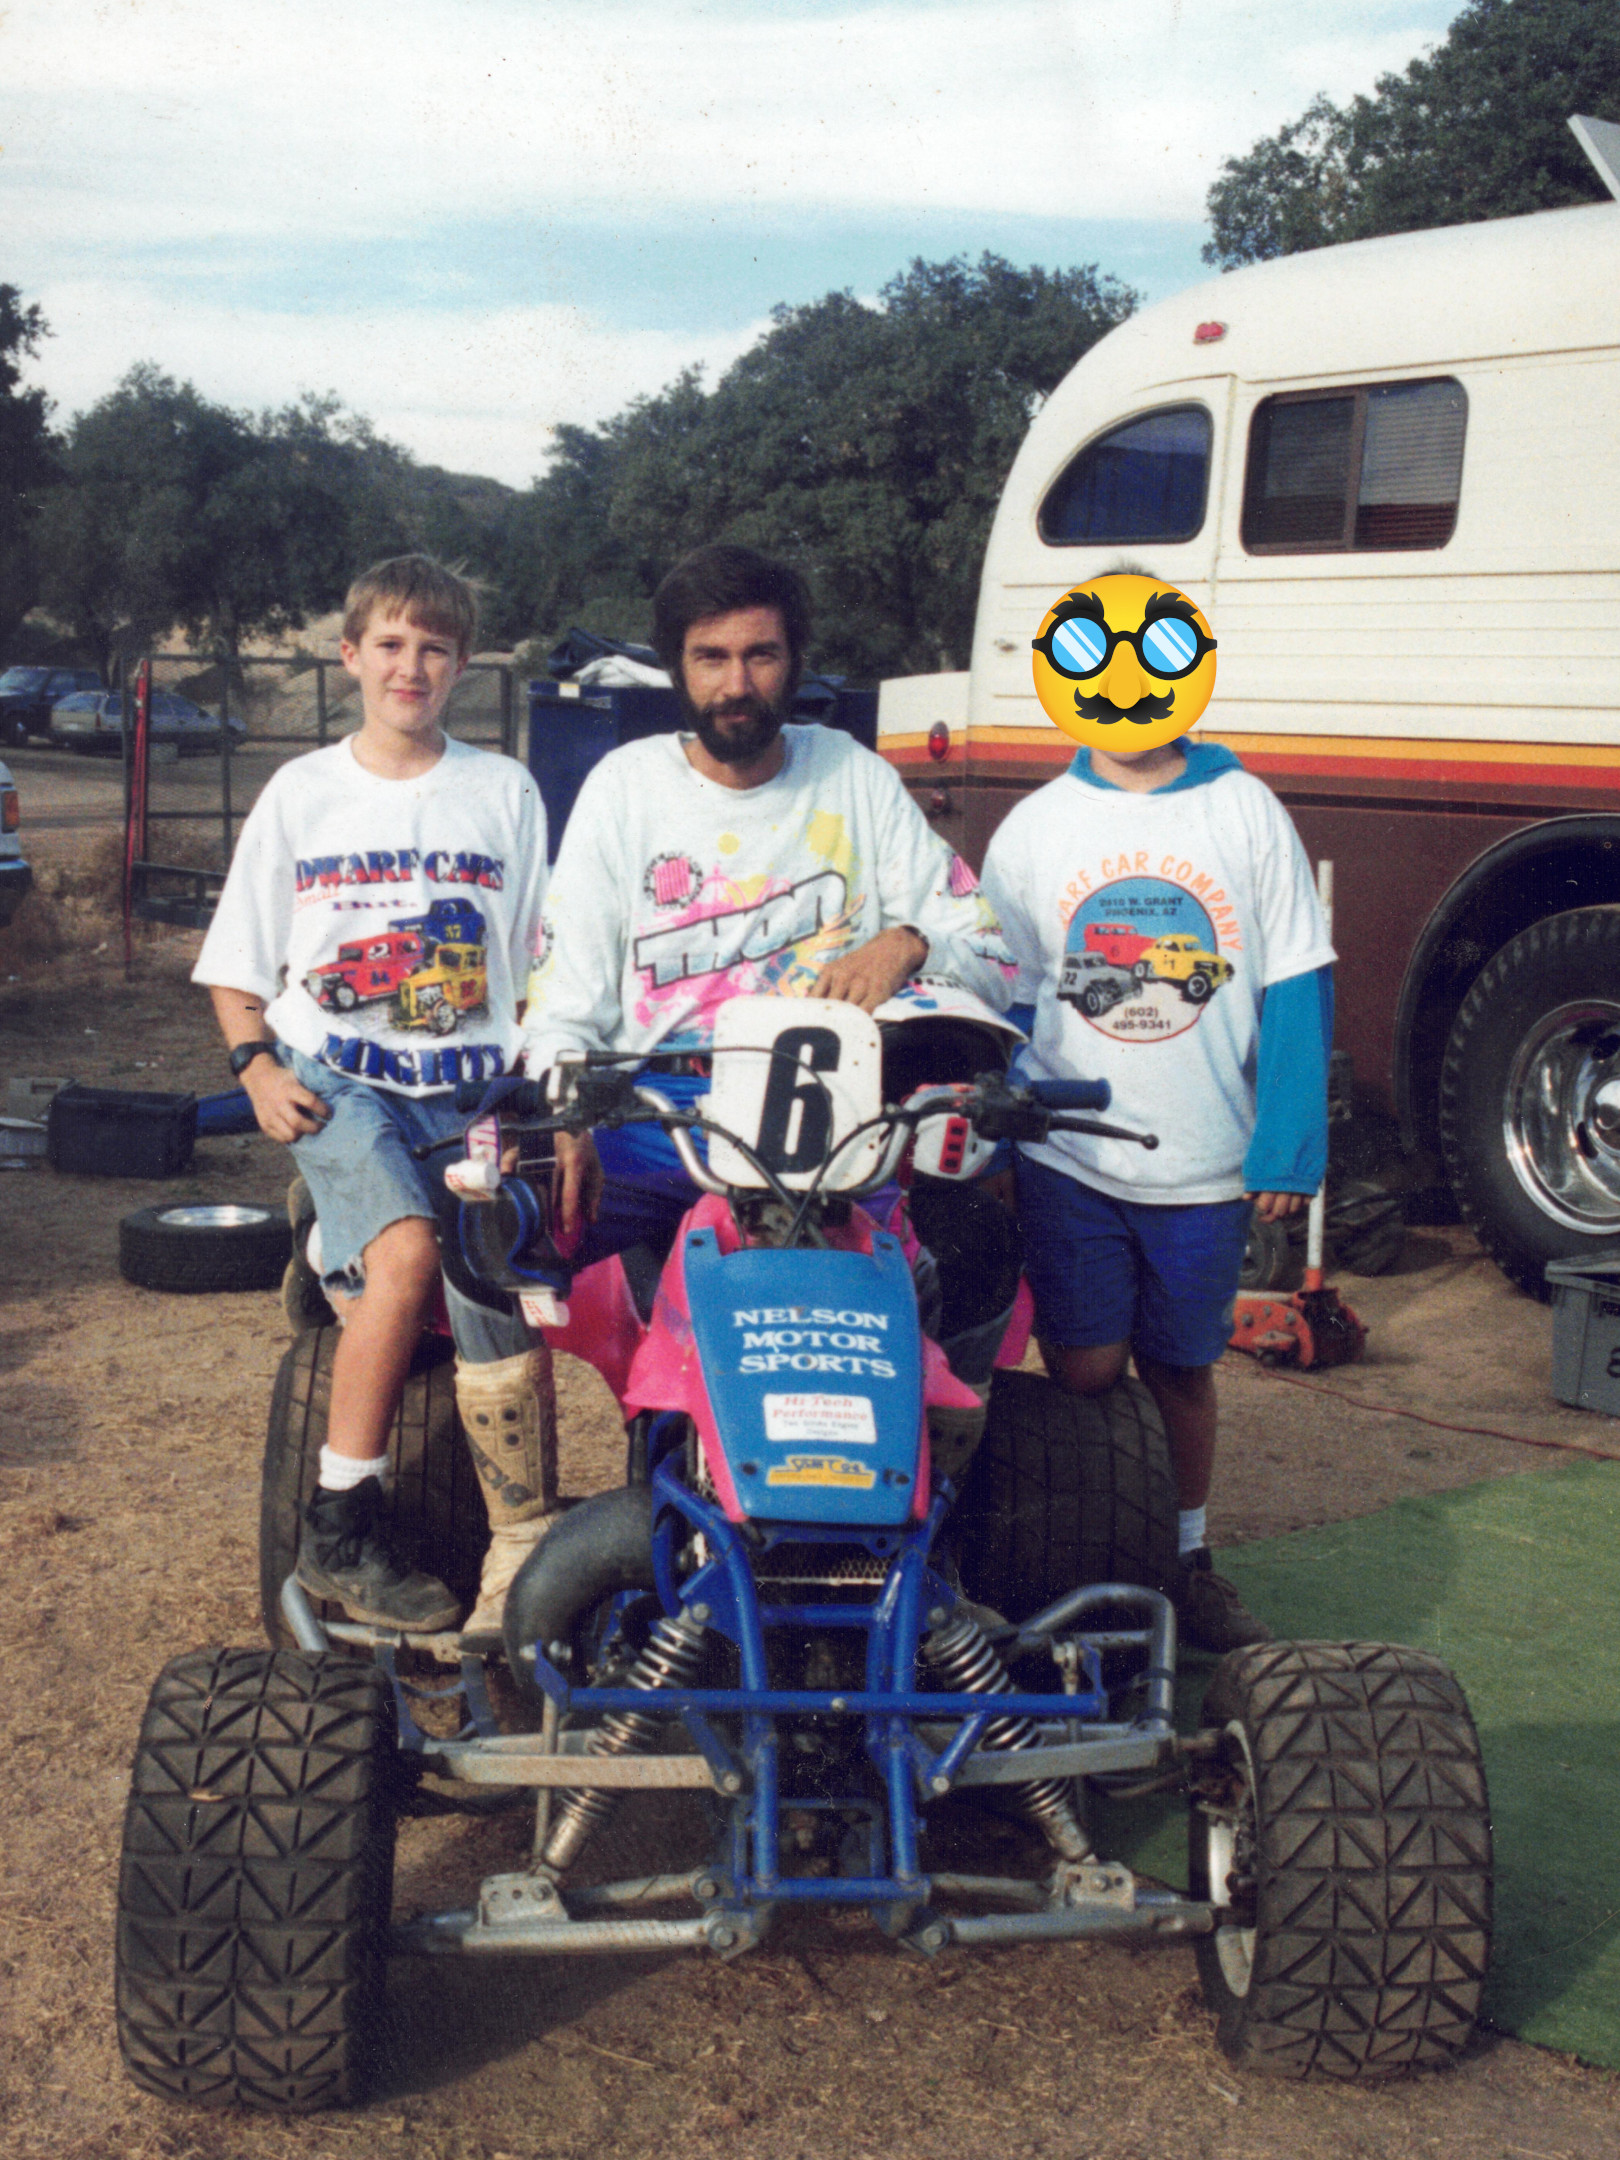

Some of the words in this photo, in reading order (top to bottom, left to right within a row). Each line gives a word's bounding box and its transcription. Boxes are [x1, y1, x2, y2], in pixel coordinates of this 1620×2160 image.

[296, 847, 420, 892] DWARF
[424, 850, 505, 890] CARS
[1101, 851, 1149, 879] CAR
[1160, 854, 1244, 950] COMPANY
[1144, 896, 1184, 906] GRANT
[1162, 907, 1177, 917] AZ
[1124, 1006, 1159, 1019] (602)
[1112, 1019, 1171, 1030] 495-9341
[756, 1026, 841, 1174] 6
[733, 1307, 889, 1330] NELSON
[742, 1330, 884, 1353] MOTOR
[739, 1353, 896, 1378] SPORTS
[784, 1395, 805, 1406] Hi
[812, 1394, 853, 1407] Tech
[772, 1408, 868, 1421] Performance
